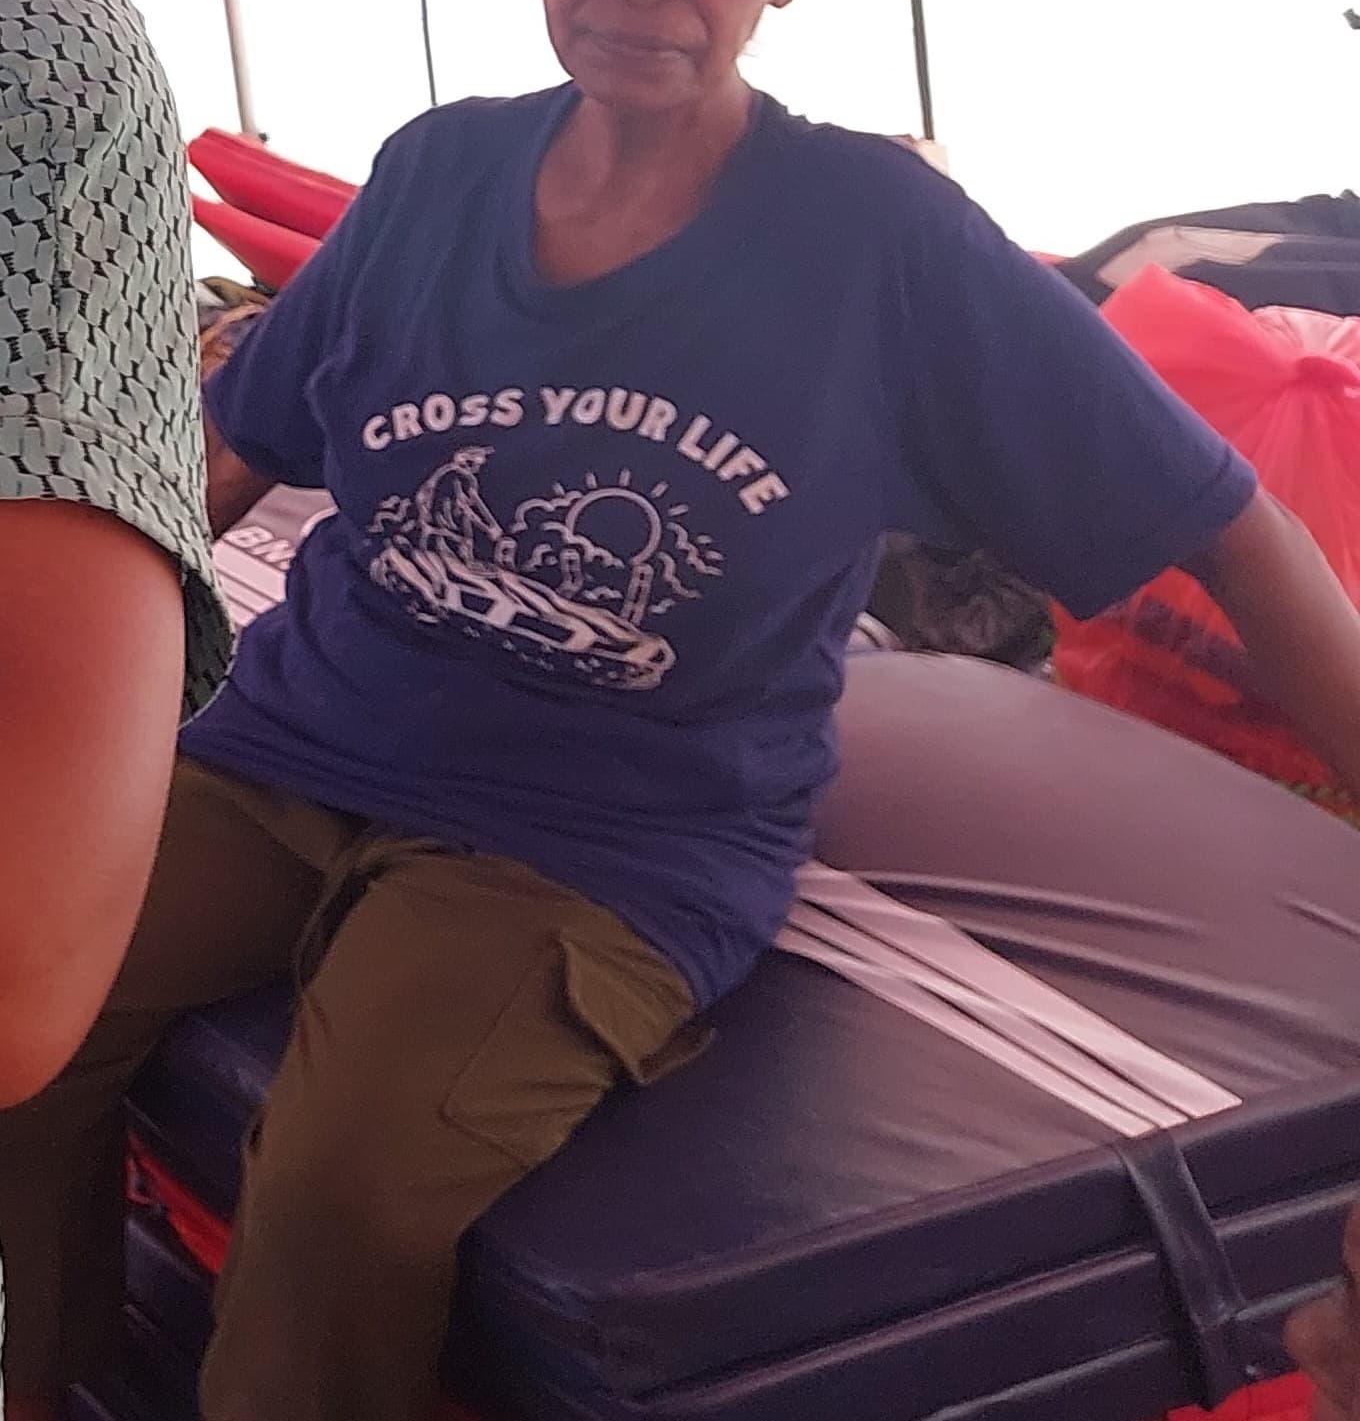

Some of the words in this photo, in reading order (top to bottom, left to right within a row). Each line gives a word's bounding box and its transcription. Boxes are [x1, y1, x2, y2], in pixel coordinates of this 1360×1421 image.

[363, 387, 525, 451] CROSS
[539, 386, 679, 441] YOUR
[676, 414, 791, 515] LIFE
